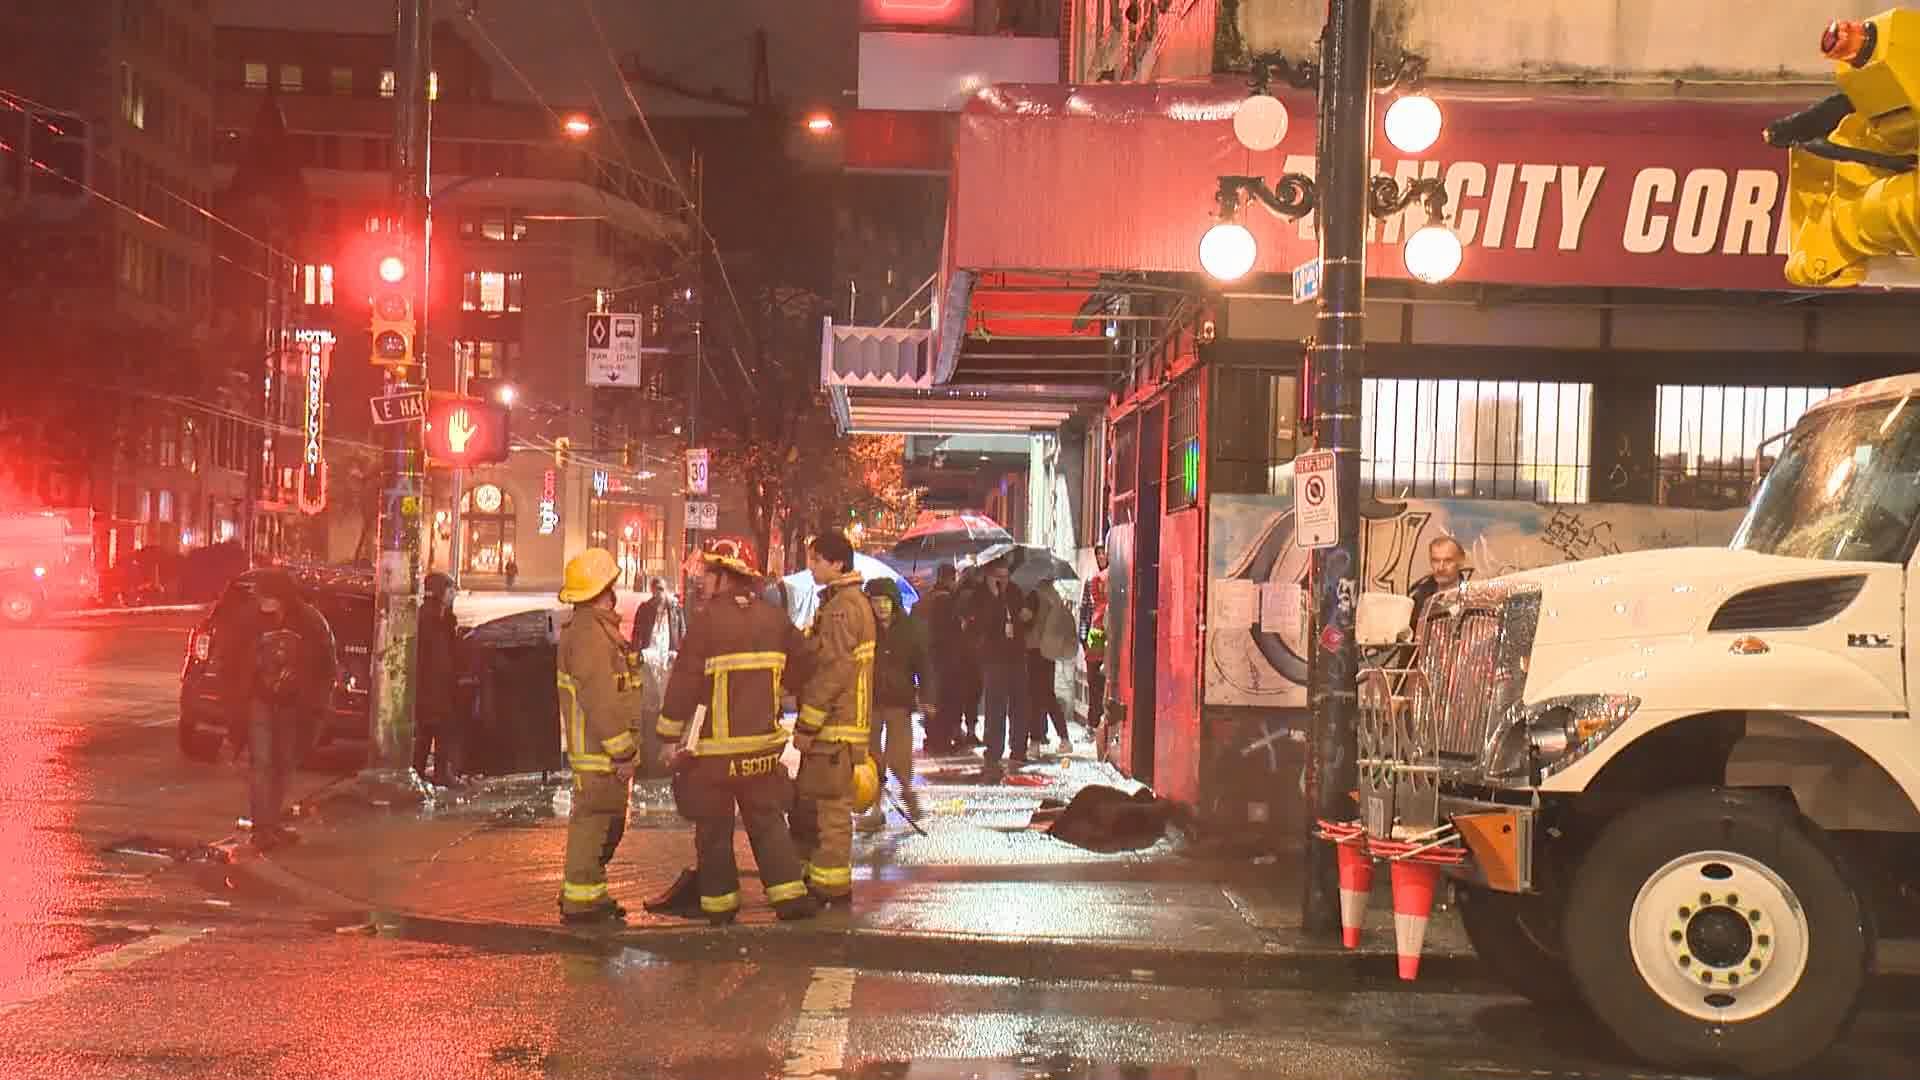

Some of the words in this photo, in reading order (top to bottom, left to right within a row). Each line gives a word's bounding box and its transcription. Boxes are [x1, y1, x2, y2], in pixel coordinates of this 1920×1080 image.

[1622, 167, 1789, 255] COR
[384, 400, 392, 418] E
[692, 462, 706, 481] 30
[729, 759, 737, 776] A
